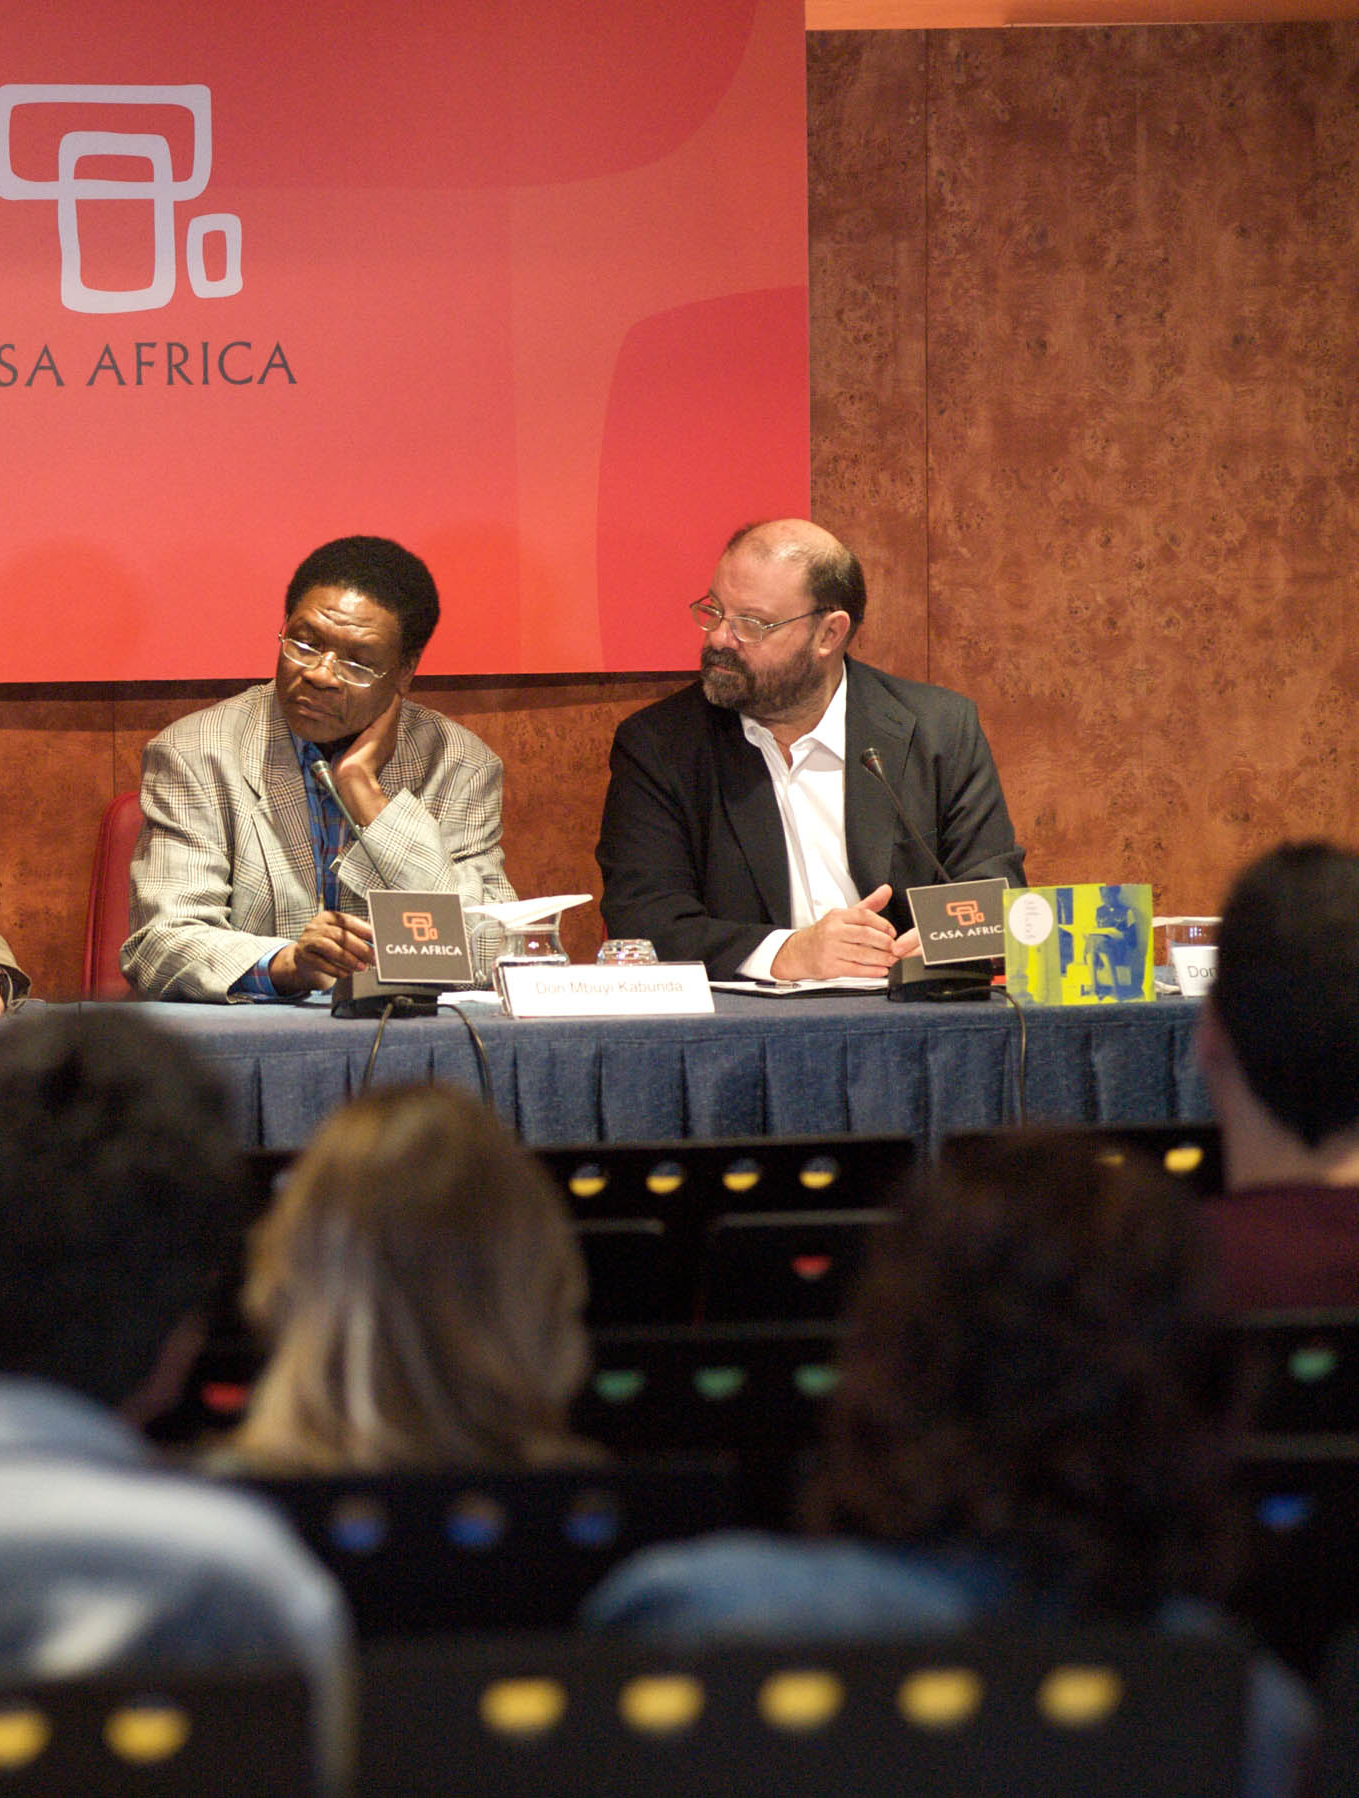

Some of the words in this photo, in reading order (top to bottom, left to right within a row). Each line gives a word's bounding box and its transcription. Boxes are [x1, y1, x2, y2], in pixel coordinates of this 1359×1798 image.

[85, 341, 297, 386] AFRICA
[929, 928, 964, 941] CASA
[967, 924, 1006, 937] AFRIC
[385, 943, 418, 955] CASA
[420, 944, 463, 956] AFRICA
[536, 980, 567, 995] Don
[569, 980, 614, 998] Mbuyi
[617, 979, 684, 994] Kabunda
